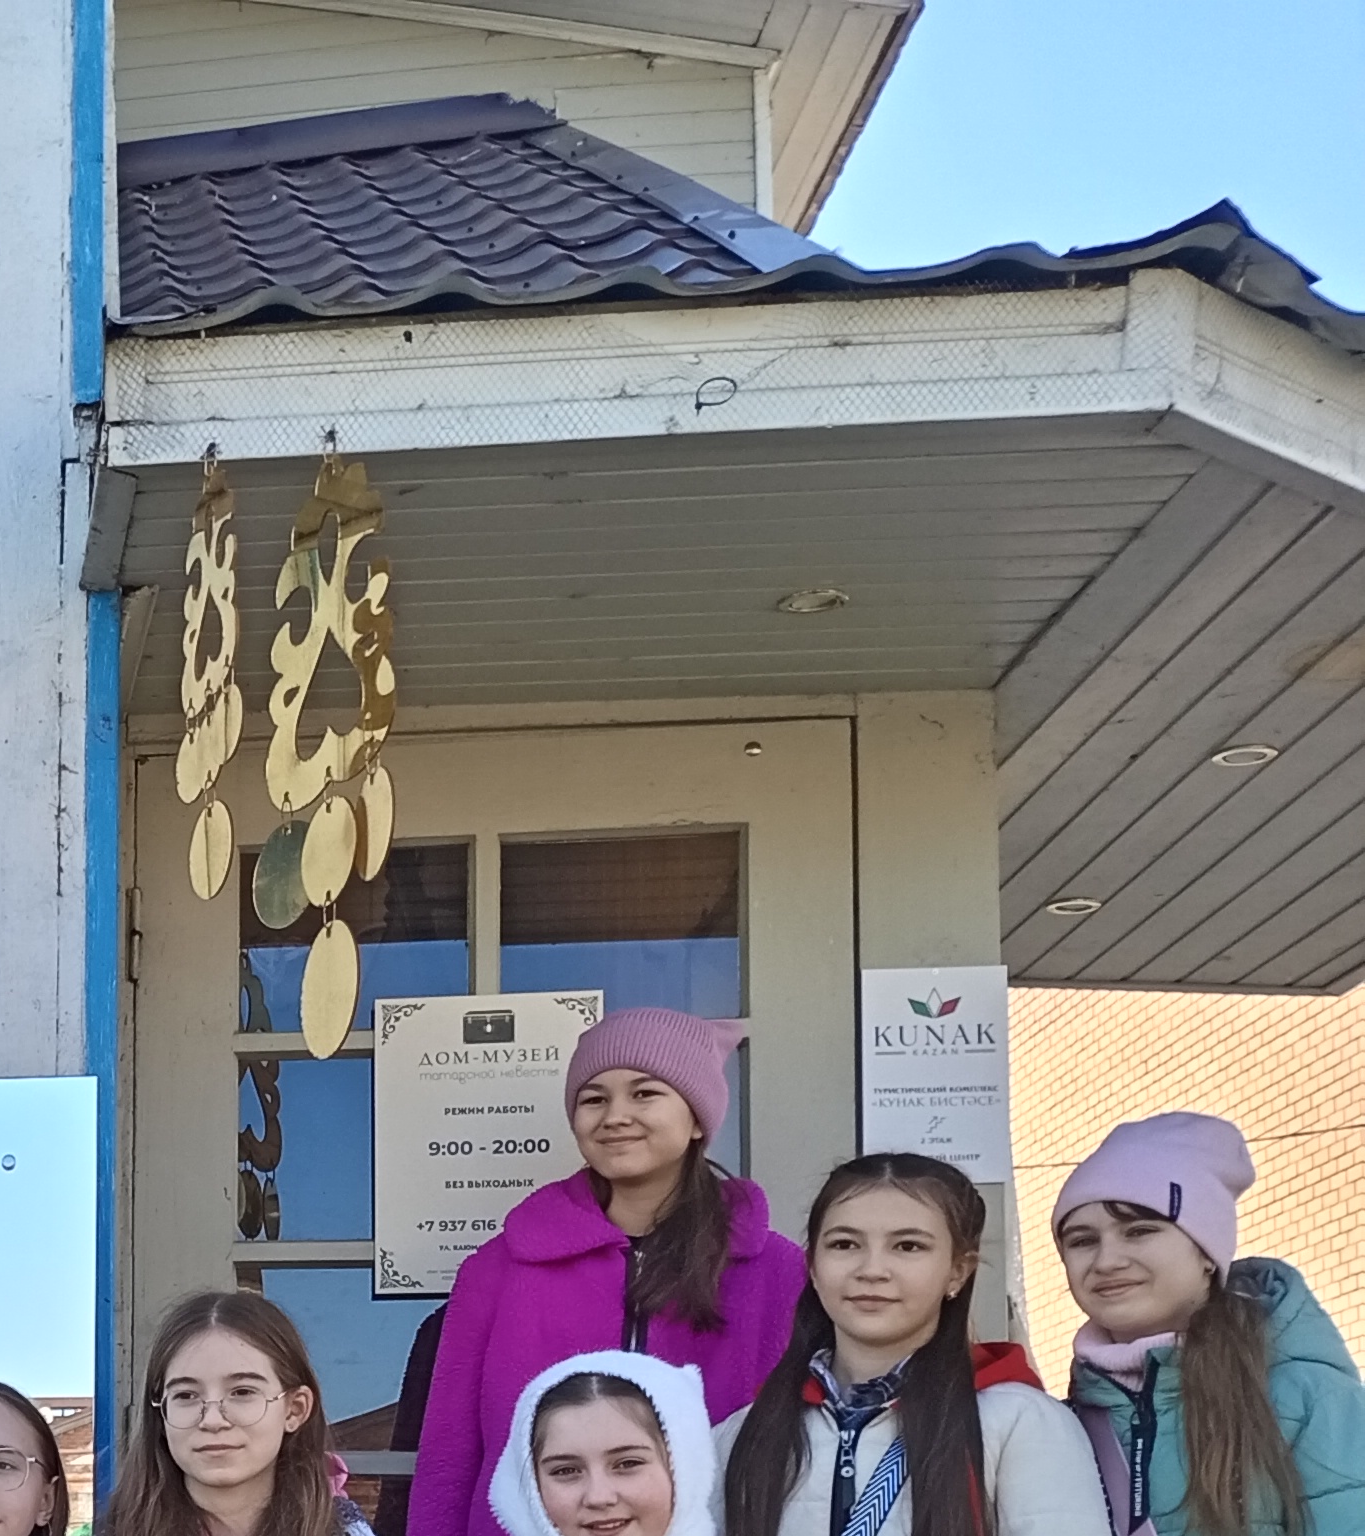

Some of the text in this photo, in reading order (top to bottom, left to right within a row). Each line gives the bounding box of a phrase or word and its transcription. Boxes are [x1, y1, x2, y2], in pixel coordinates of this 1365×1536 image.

[874, 1023, 997, 1048] KUNAK
[418, 1045, 560, 1066] ДОМ-МУЗЕЙ
[912, 1048, 959, 1056] KAZAN
[444, 1105, 535, 1115] РЕЖИМ РАБОТЫ
[428, 1141, 473, 1156] 9:00
[492, 1138, 551, 1154] 20:00
[445, 1179, 534, 1189] БЕЗ ВЫХОДНЫХ
[416, 1219, 497, 1232] +7 937 616
